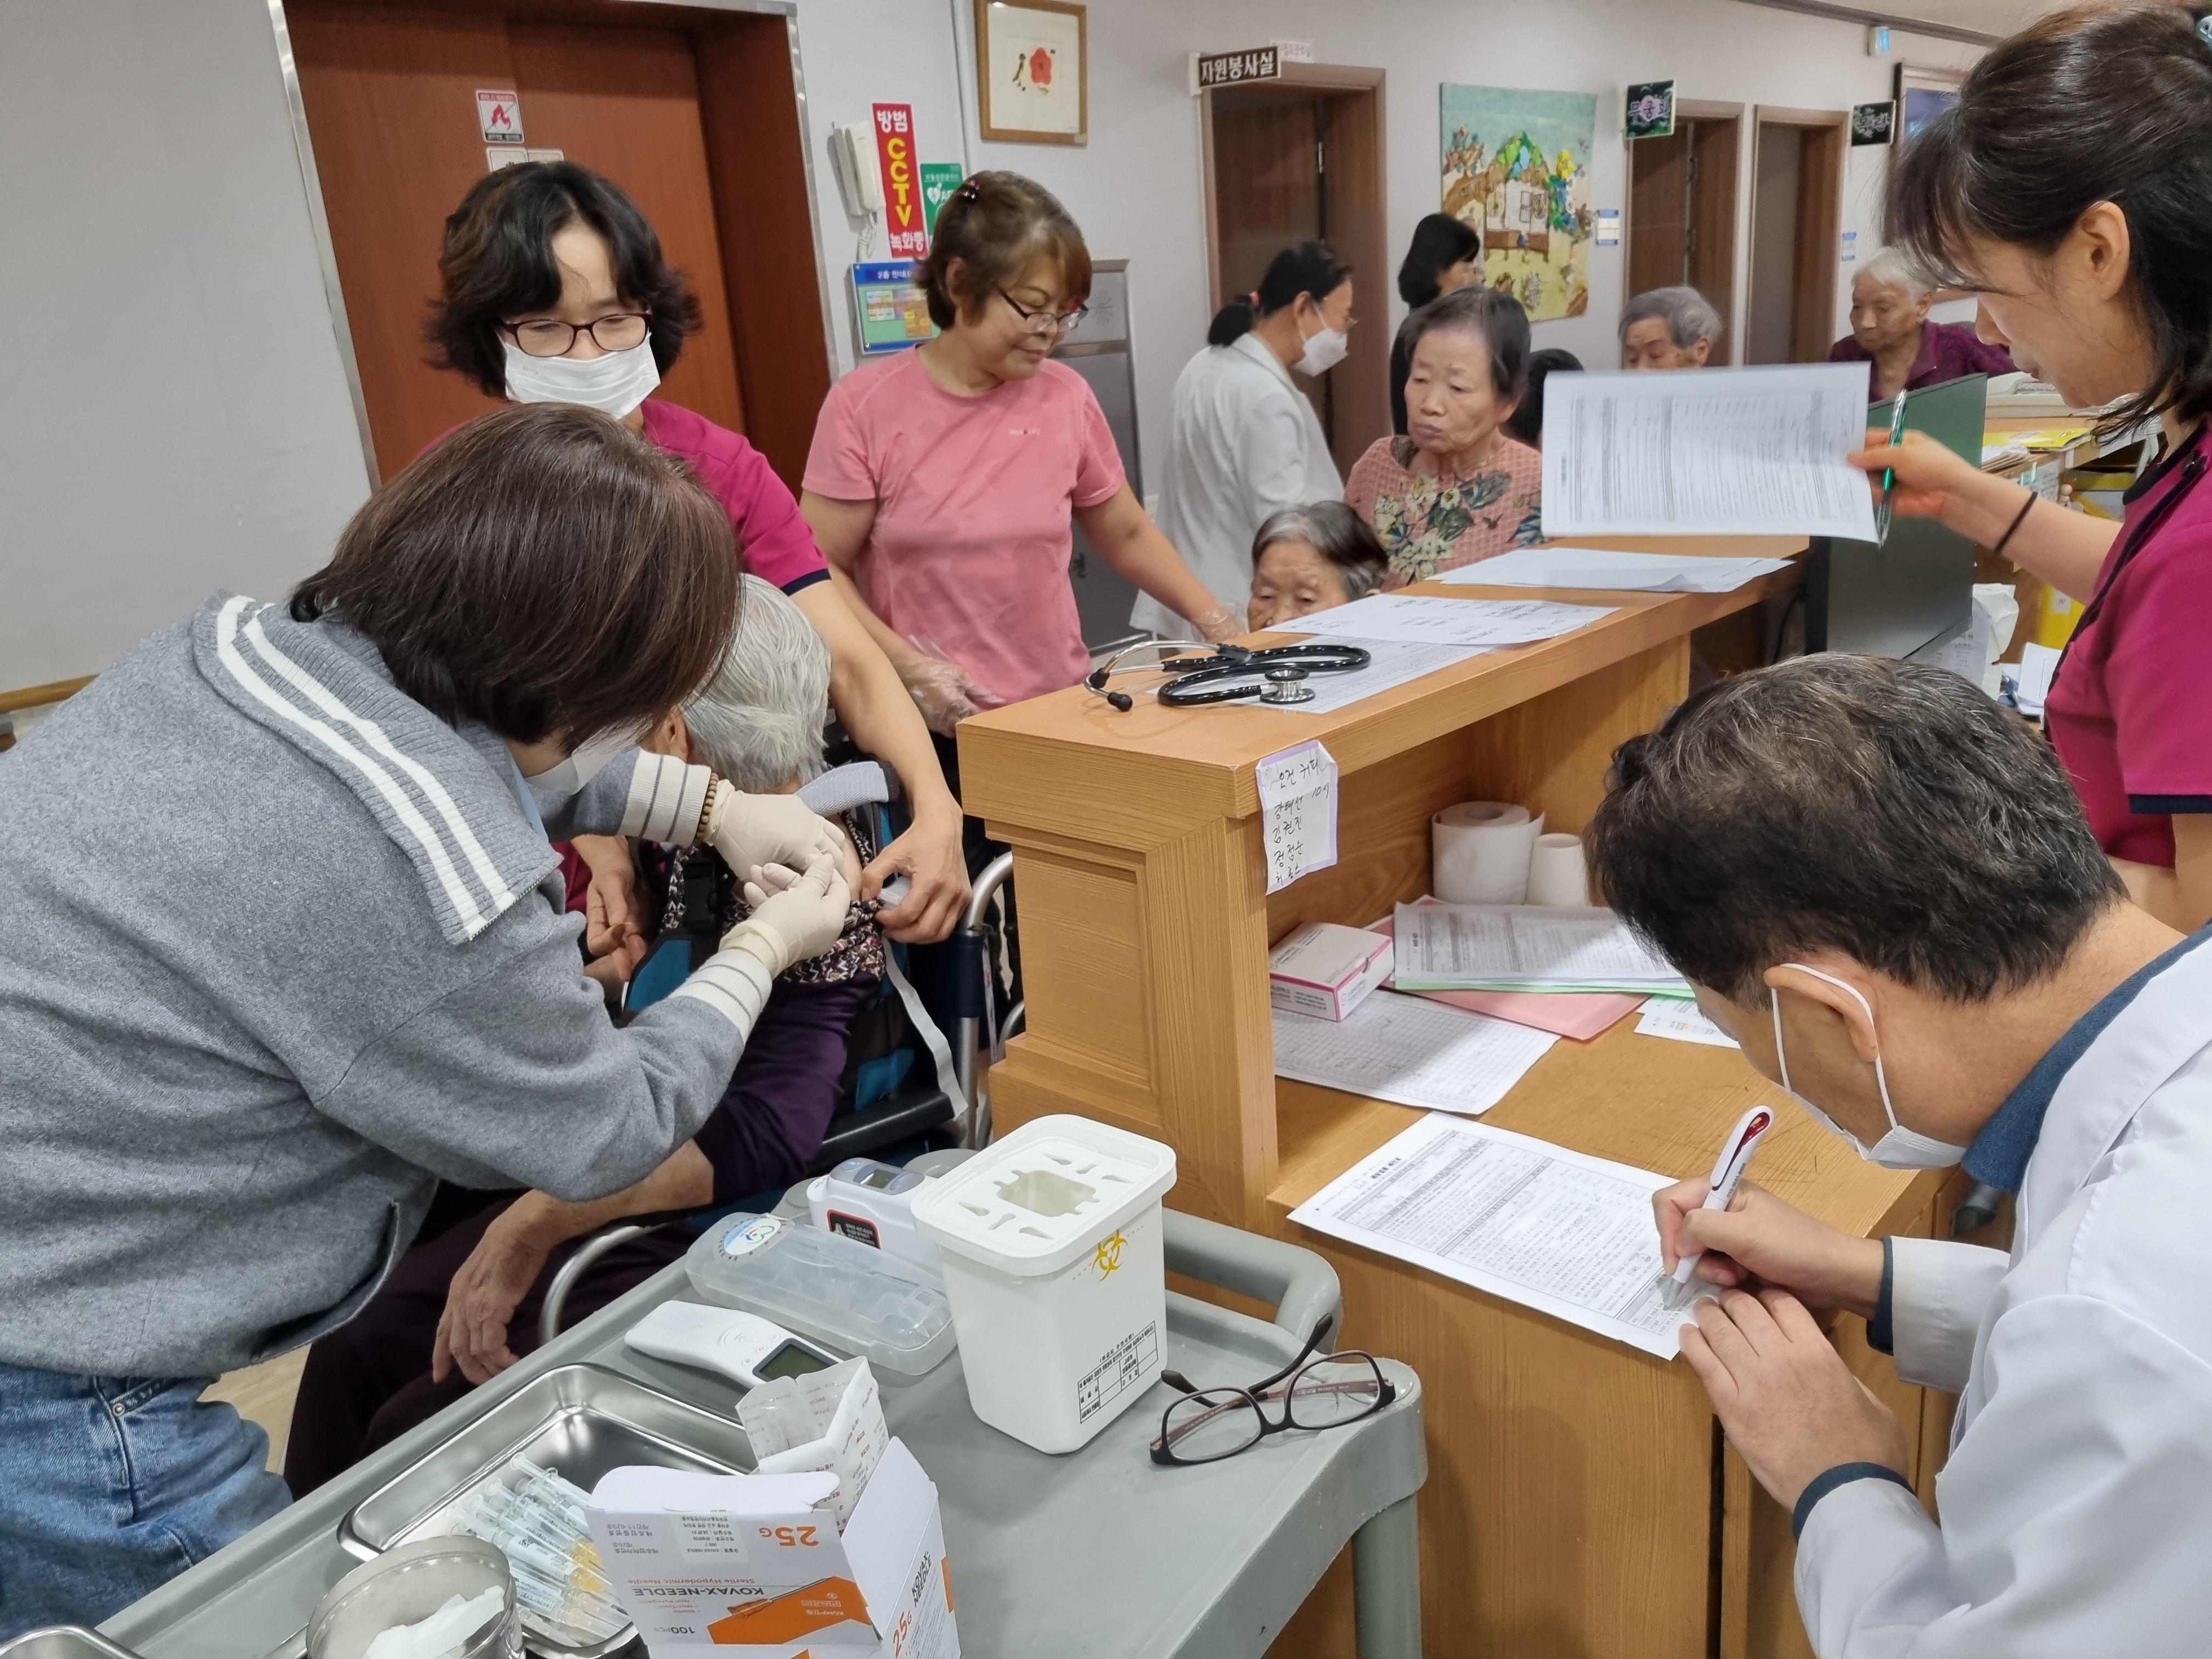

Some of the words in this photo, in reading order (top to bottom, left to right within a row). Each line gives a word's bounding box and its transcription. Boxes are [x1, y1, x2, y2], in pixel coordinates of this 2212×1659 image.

[1201, 50, 1274, 83] 자원봉사실
[877, 110, 908, 133] 방범
[887, 137, 912, 227] CCTV
[759, 1526, 819, 1547] 25G
[632, 1587, 764, 1596] KOVAX-NEEDLE
[912, 1550, 929, 1597] KOVAX-
[914, 1555, 932, 1608] NEEDLE
[893, 1610, 912, 1659] 25G
